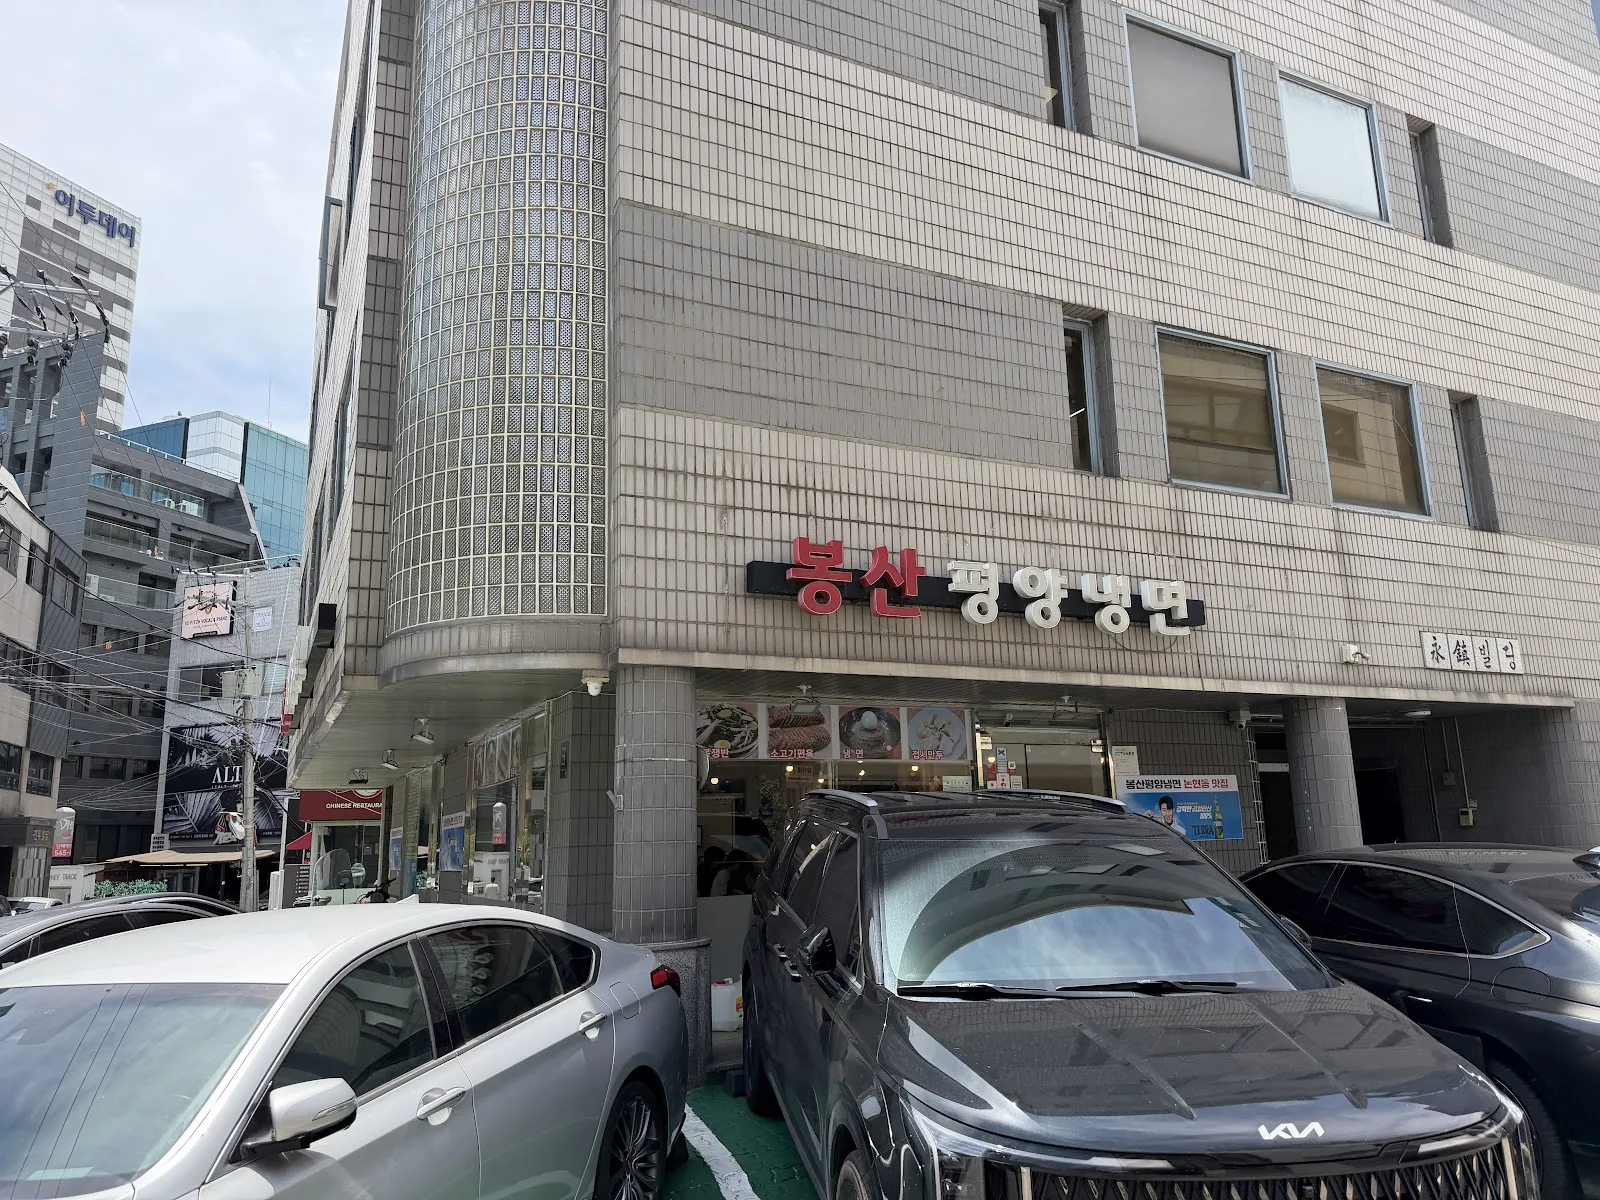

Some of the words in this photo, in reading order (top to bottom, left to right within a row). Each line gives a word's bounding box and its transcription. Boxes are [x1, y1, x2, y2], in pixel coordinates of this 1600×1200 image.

[55, 189, 136, 248] 이투데이
[786, 536, 926, 618] 봉산
[947, 560, 1191, 637] 평양냉면
[770, 748, 814, 759] 소고기편육
[911, 749, 944, 760] 접시만두
[1125, 779, 1182, 790] 봉산평양냉면
[1183, 778, 1210, 789] 논현동
[1211, 778, 1229, 789] 맛집
[1191, 825, 1214, 836] TERRA
[1257, 1121, 1325, 1140] KIA
